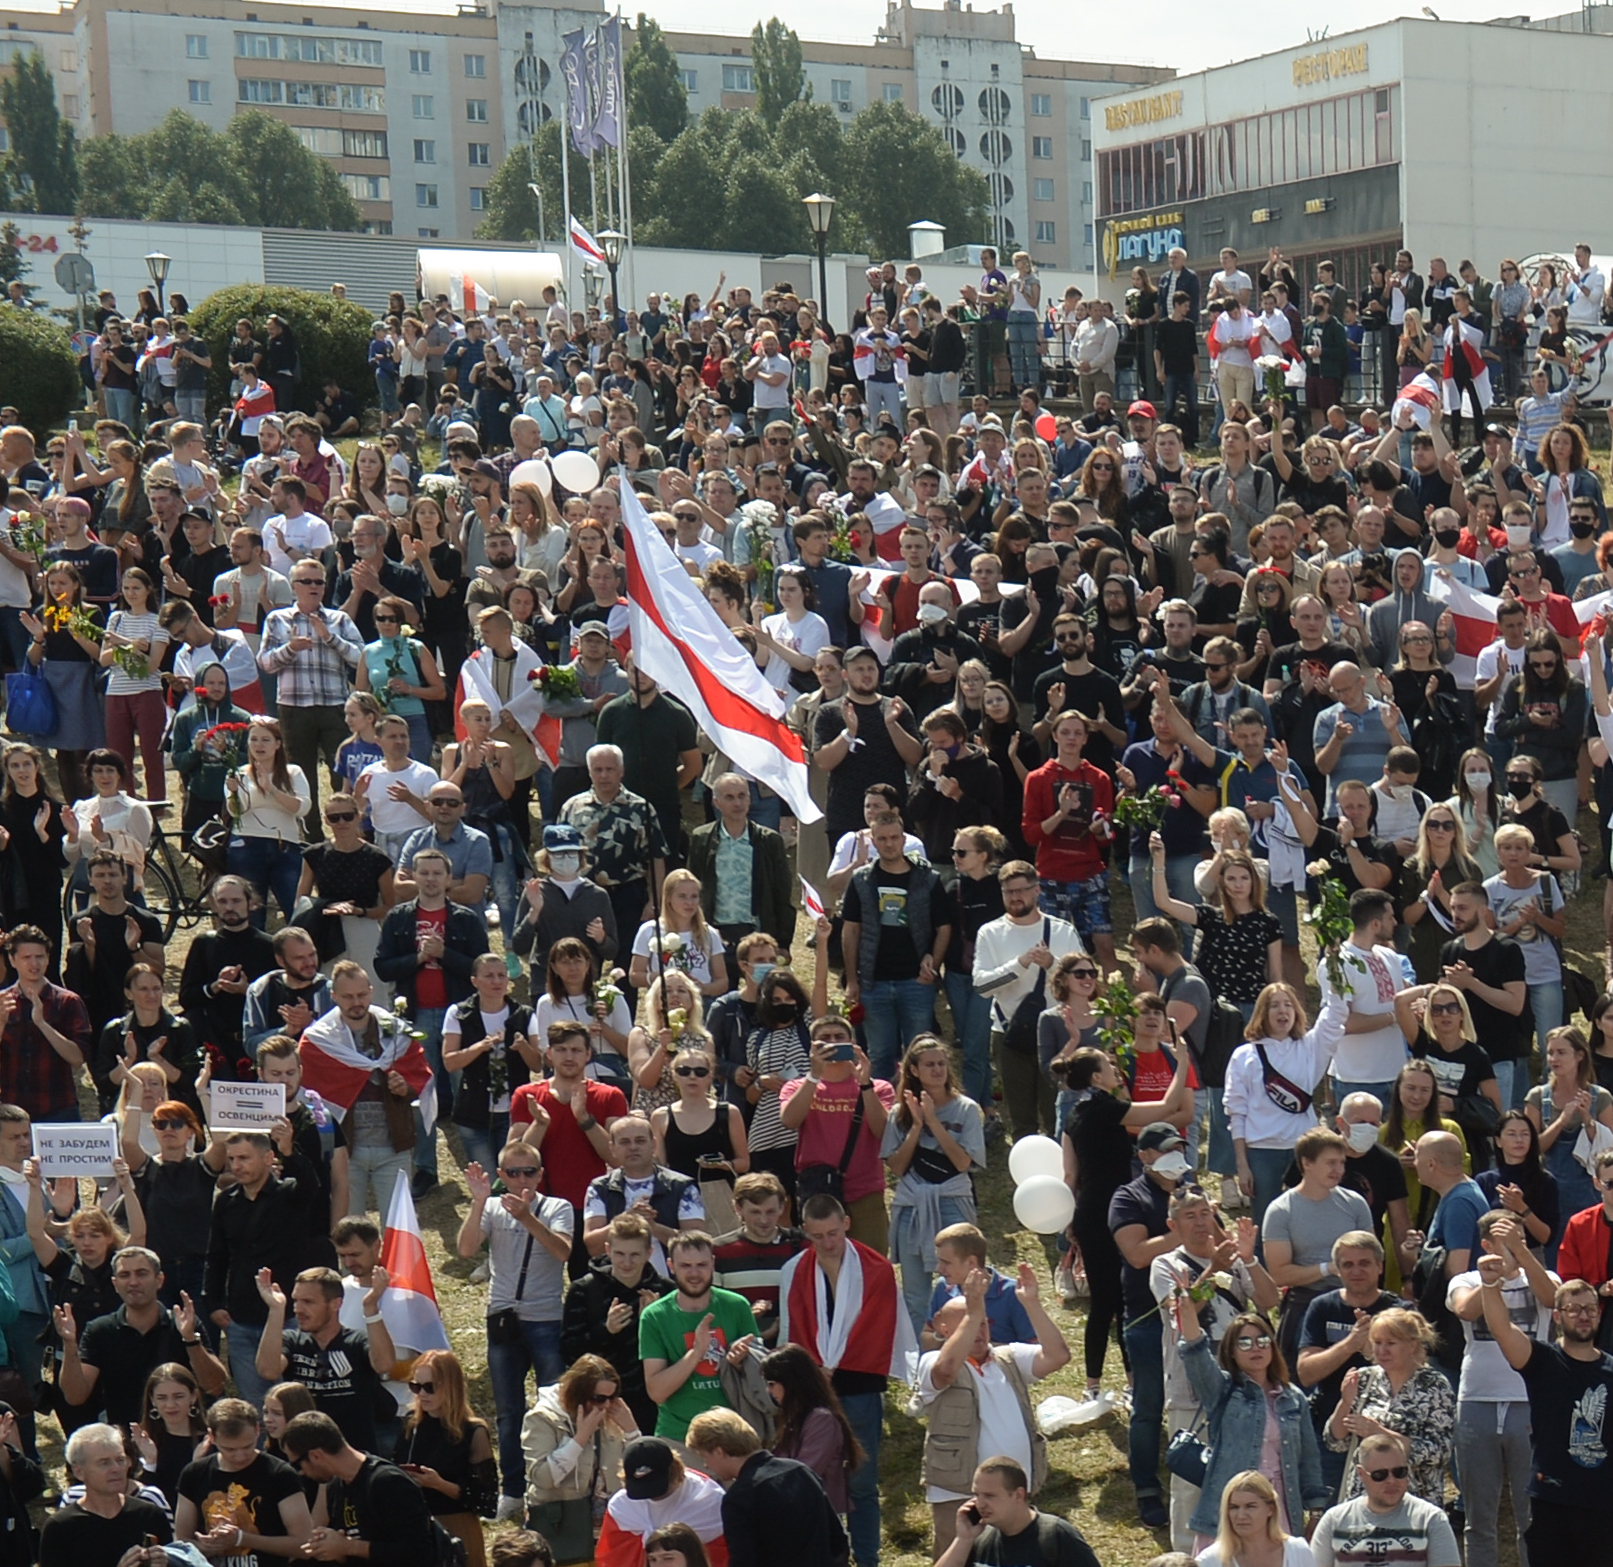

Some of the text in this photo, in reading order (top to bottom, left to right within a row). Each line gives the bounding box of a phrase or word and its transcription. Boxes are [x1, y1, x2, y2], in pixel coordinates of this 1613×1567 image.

[1117, 229, 1184, 262] ЛАГУНА
[218, 1085, 280, 1097] ОКРЕСТИНА
[1267, 1086, 1298, 1111] FILA
[218, 1111, 280, 1123] ОСВЕНЦИМ
[41, 1140, 111, 1150] НЕ ЗАБУДЕМ
[41, 1155, 112, 1164] НЕ ПРОСТИМ
[692, 1380, 720, 1391] LIETU
